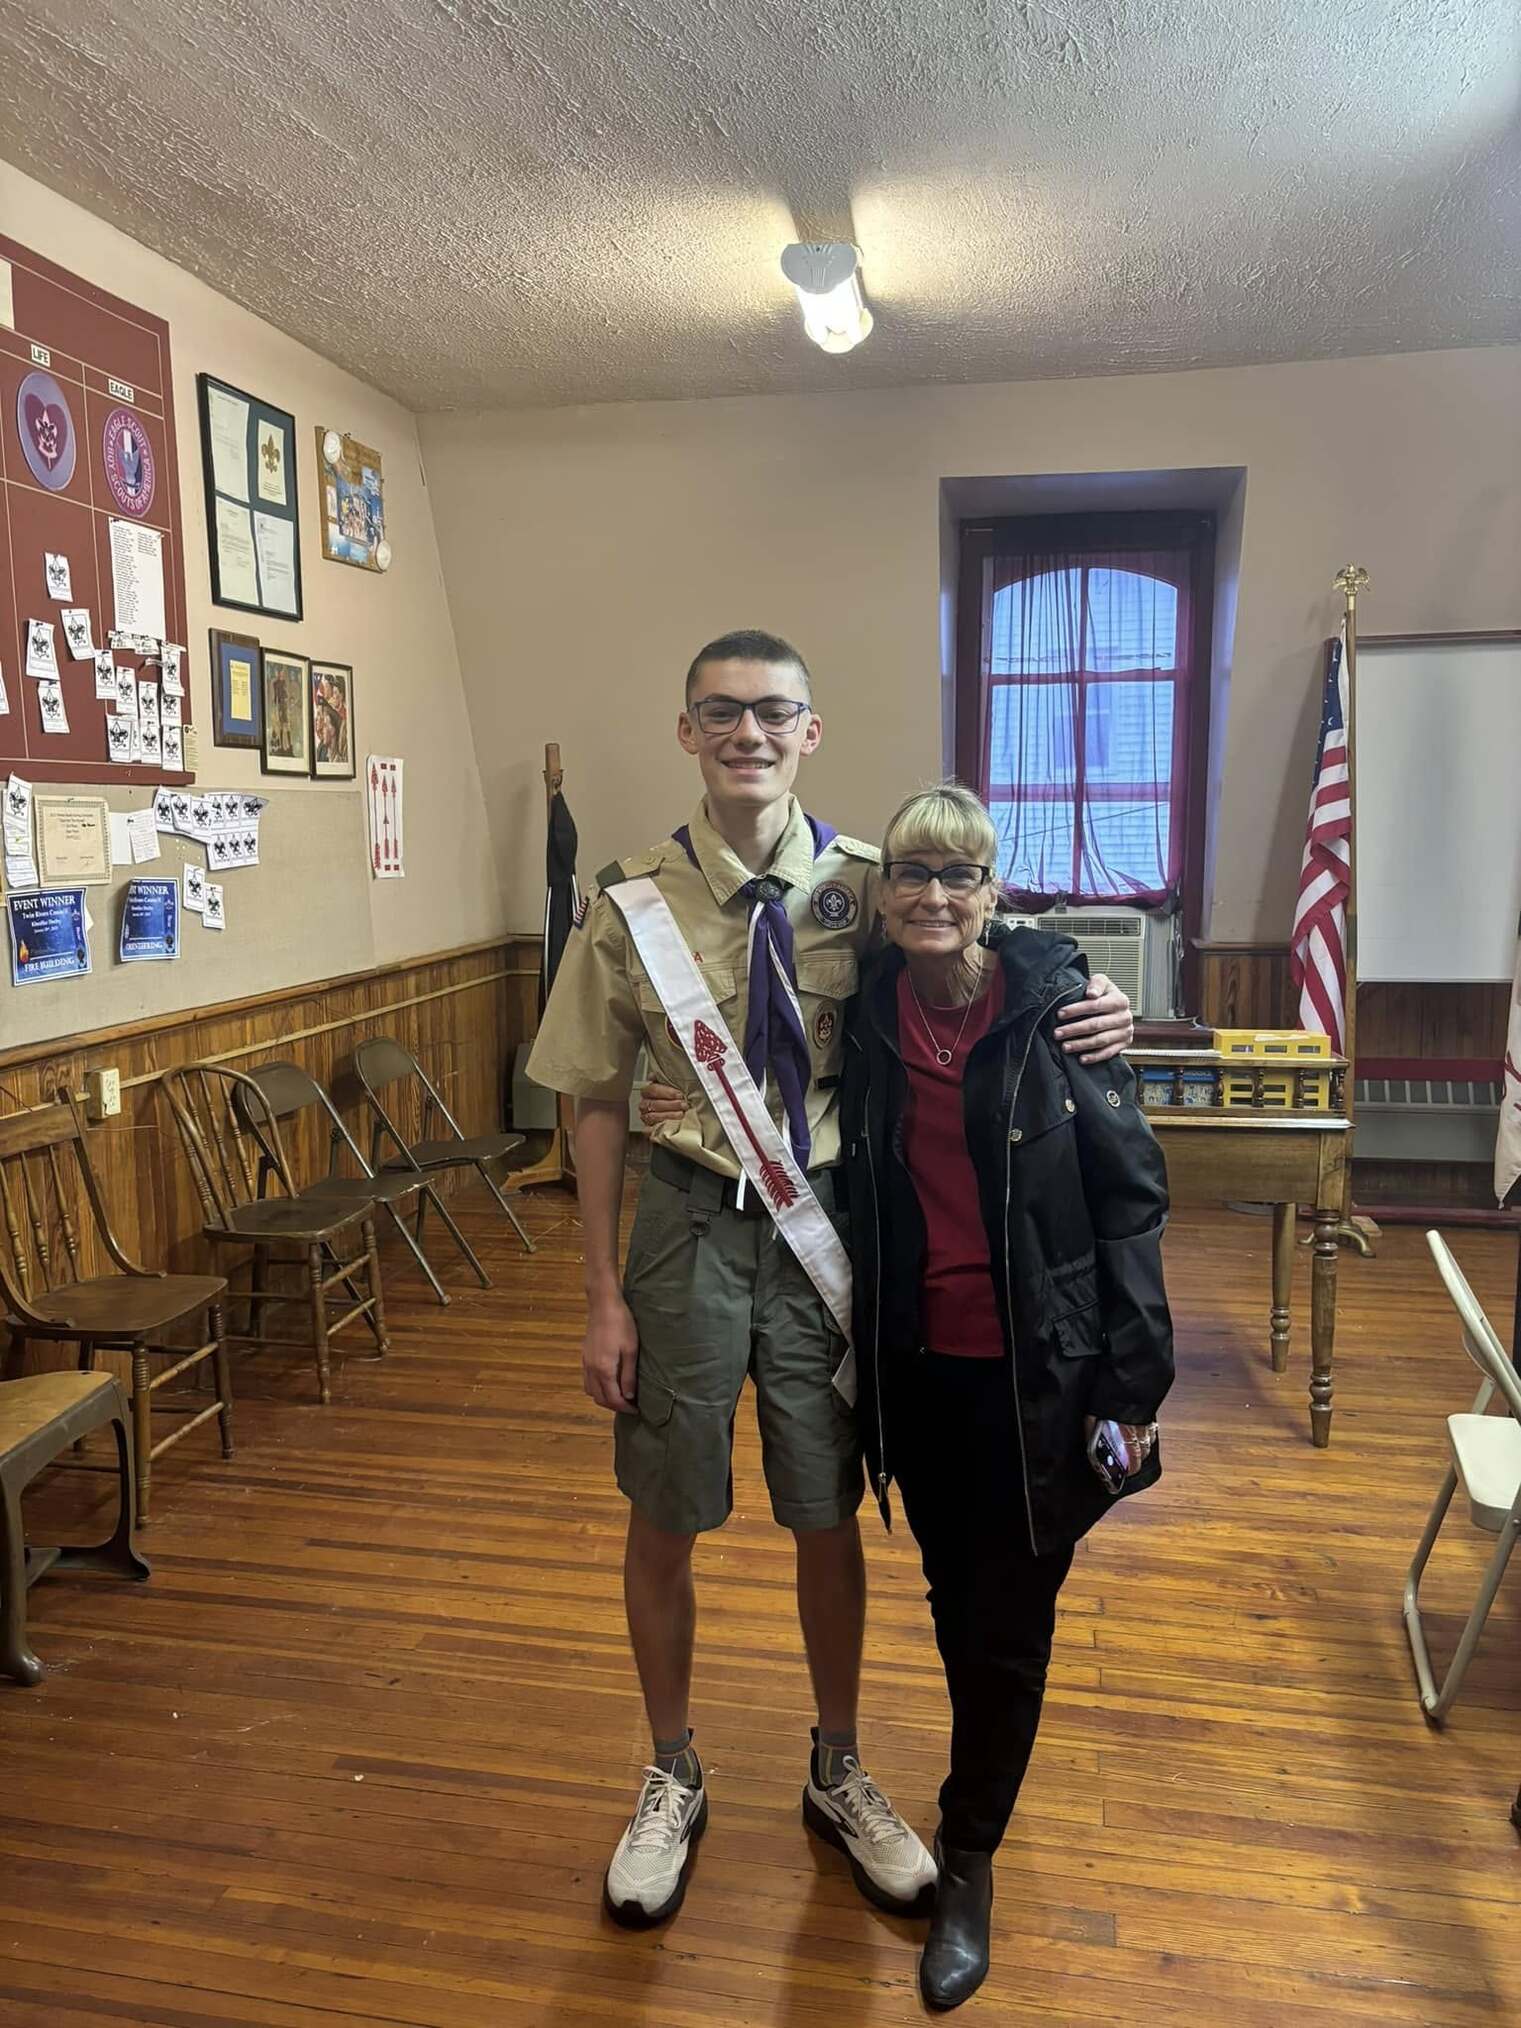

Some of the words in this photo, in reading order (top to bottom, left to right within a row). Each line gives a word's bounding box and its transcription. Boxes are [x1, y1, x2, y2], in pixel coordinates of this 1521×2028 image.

[33, 348, 49, 363] LIFE
[110, 381, 132, 400] EAGLE
[108, 415, 126, 441] EAGLE
[107, 446, 116, 470] BOY
[141, 458, 153, 504] AMERICA
[111, 473, 135, 510] SCOUTS
[137, 885, 169, 895] WINNER
[14, 899, 39, 911] EVENT
[40, 896, 76, 907] WINNER
[24, 963, 40, 972] FIRE
